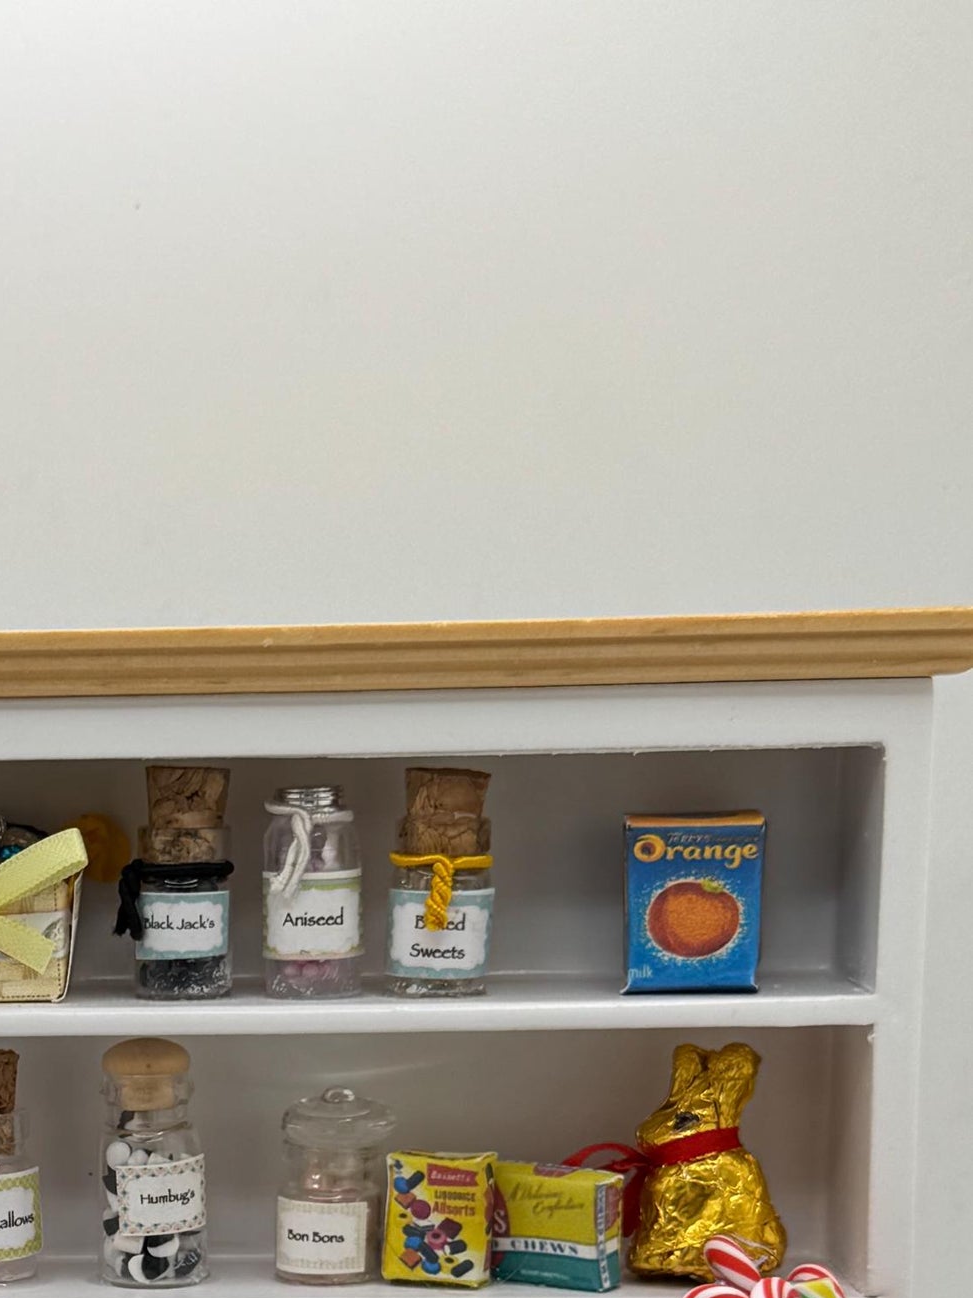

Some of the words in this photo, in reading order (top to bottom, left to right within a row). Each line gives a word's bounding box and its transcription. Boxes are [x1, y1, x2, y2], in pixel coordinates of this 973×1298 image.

[633, 834, 759, 869] Orange
[143, 914, 174, 930] Black
[175, 915, 215, 931] Jack's
[282, 907, 345, 927] Aniseed
[414, 912, 466, 931] Bed
[409, 942, 465, 960] Sweets
[628, 965, 653, 980] milk
[139, 1189, 196, 1206] Humbug's
[431, 1202, 476, 1217] Allsorts
[286, 1228, 309, 1243] Bon
[311, 1231, 345, 1244] Bons
[510, 1239, 579, 1256] CHEWS
